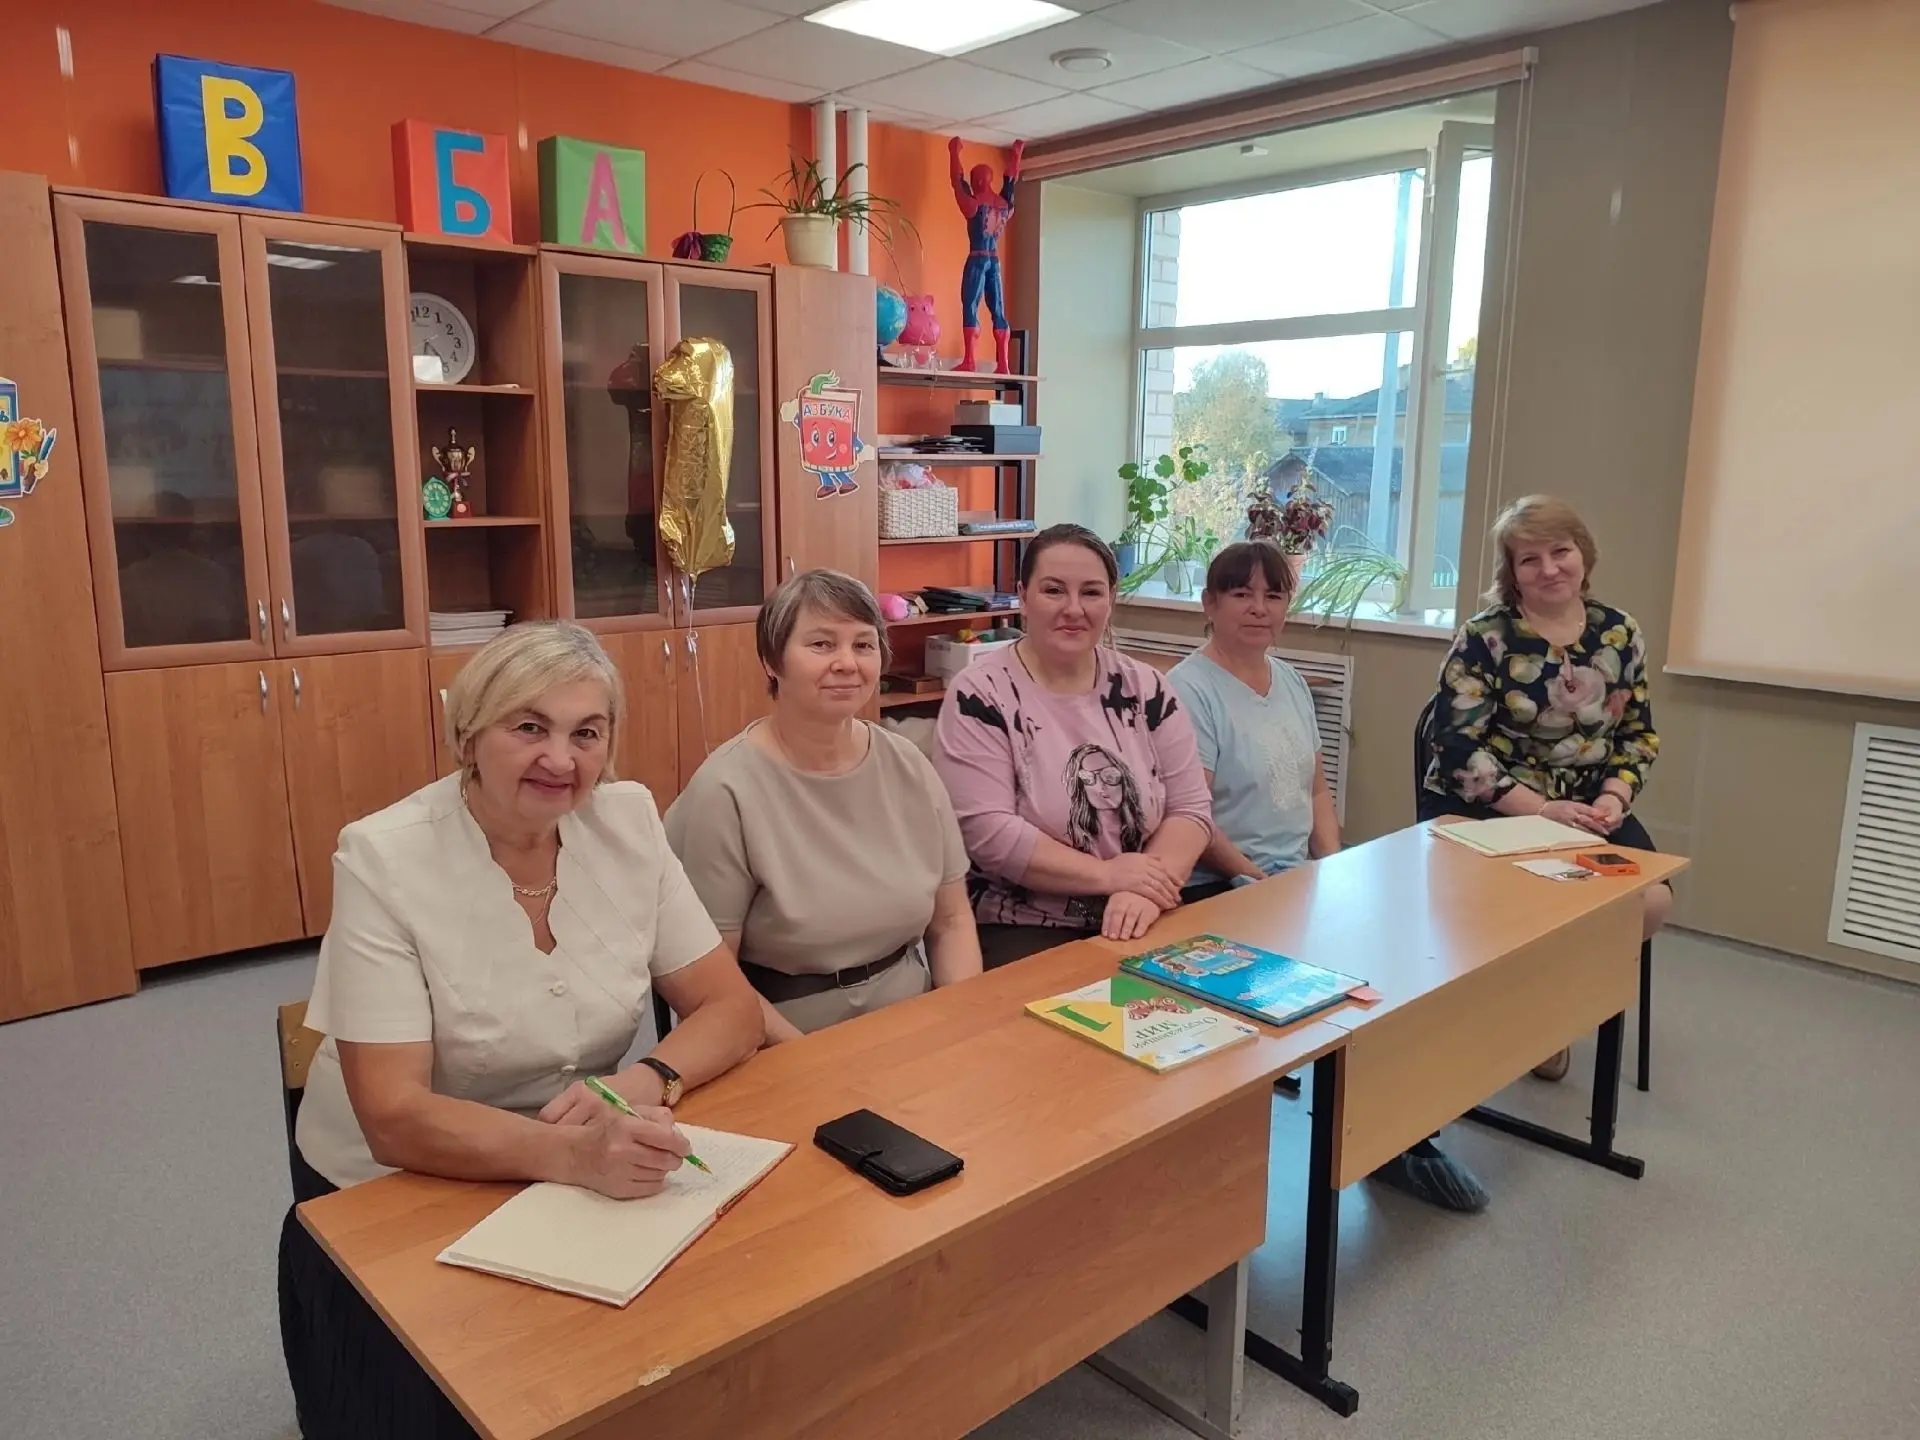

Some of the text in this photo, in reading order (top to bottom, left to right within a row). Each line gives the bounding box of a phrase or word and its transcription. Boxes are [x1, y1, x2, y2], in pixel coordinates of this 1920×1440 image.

[201, 75, 267, 196] В
[434, 129, 491, 236] Б
[581, 151, 627, 247] А
[415, 305, 429, 318] 12
[435, 312, 442, 323] 1
[445, 323, 454, 335] 2
[453, 337, 461, 348] 3
[449, 350, 458, 362] 4
[803, 402, 852, 419] АЗБУКА
[1044, 1004, 1112, 1032] 1
